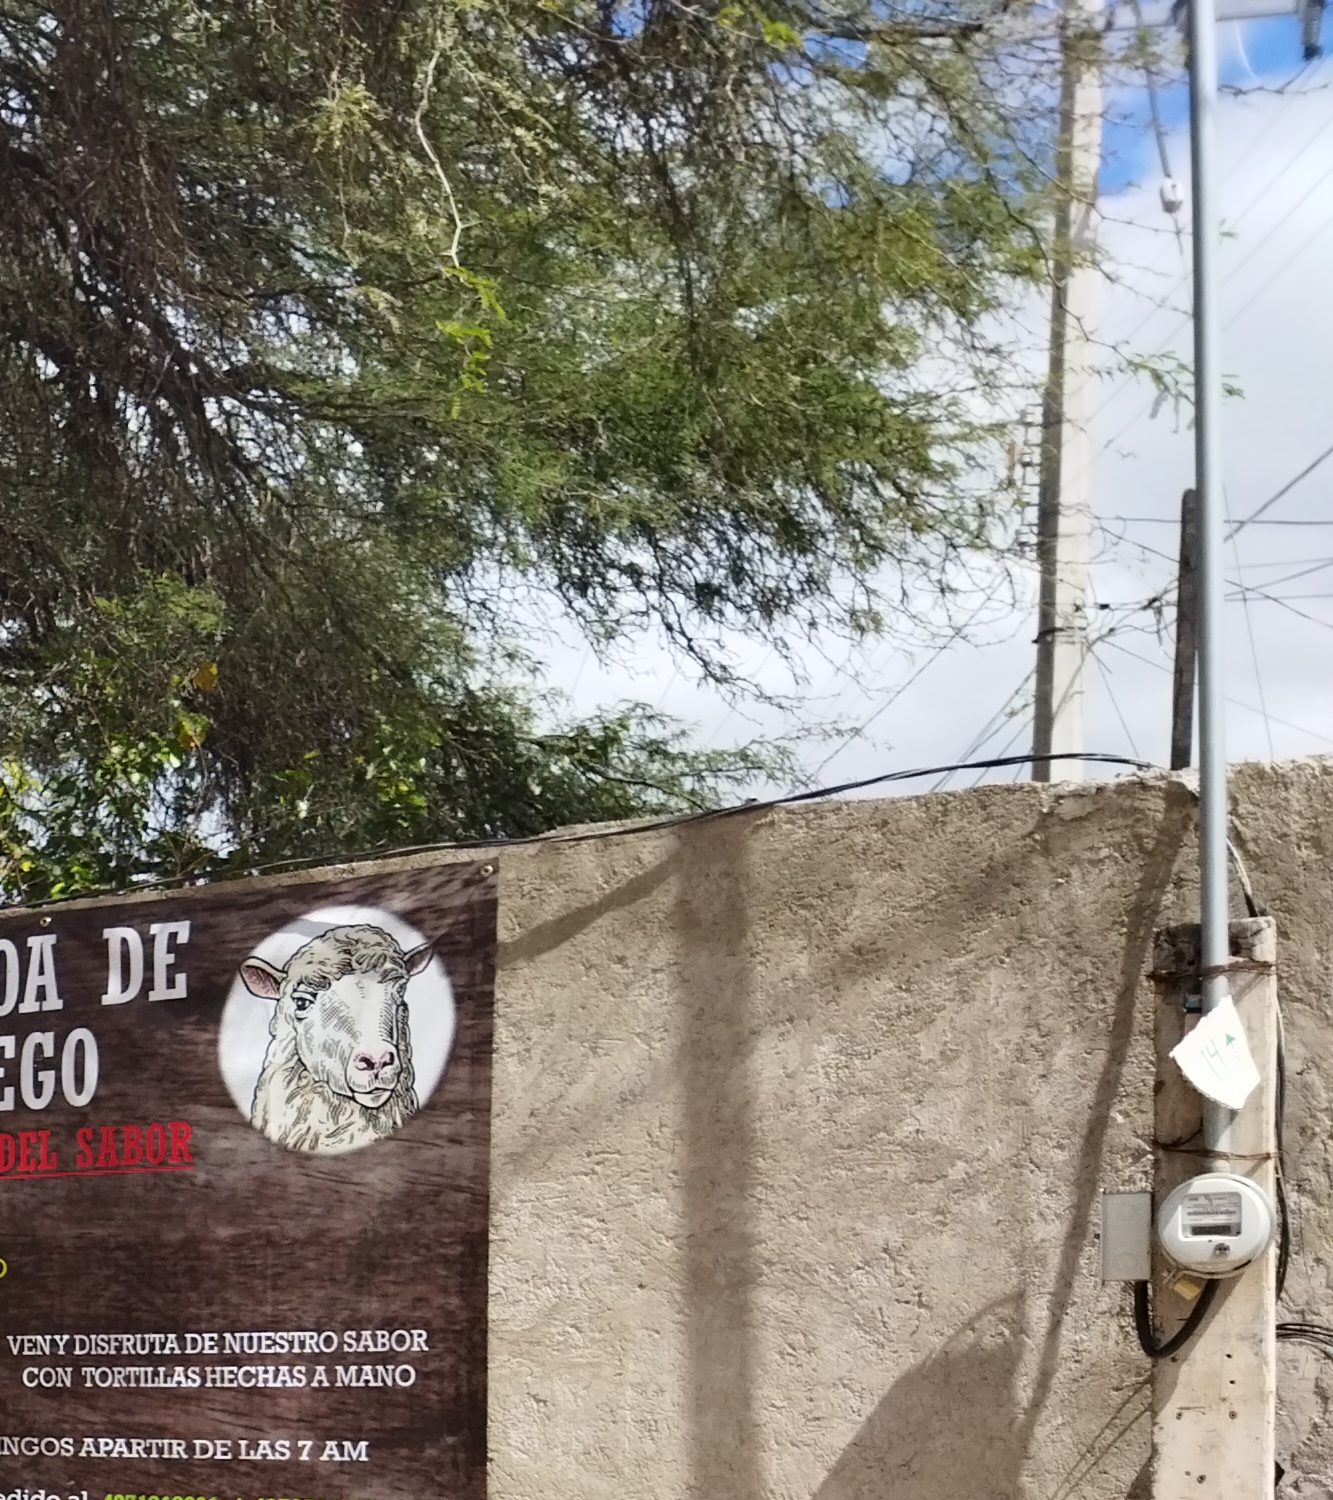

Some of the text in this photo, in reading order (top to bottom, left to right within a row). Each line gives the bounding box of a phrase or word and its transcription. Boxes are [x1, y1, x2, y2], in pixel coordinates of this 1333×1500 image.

[101, 919, 191, 1006] DE
[76, 1121, 194, 1168] SABOR
[73, 1333, 181, 1356] DISFRUTA
[185, 1333, 219, 1354] DE
[222, 1331, 338, 1354] NUESTRO
[342, 1329, 430, 1353] SABOR
[22, 1364, 417, 1388] CON TORTILLAS HECHAS A MANO
[78, 1437, 188, 1459] APARTIR
[192, 1439, 232, 1460] DE
[238, 1440, 291, 1461] LAS
[297, 1440, 313, 1460] 7
[319, 1441, 369, 1462] AM
